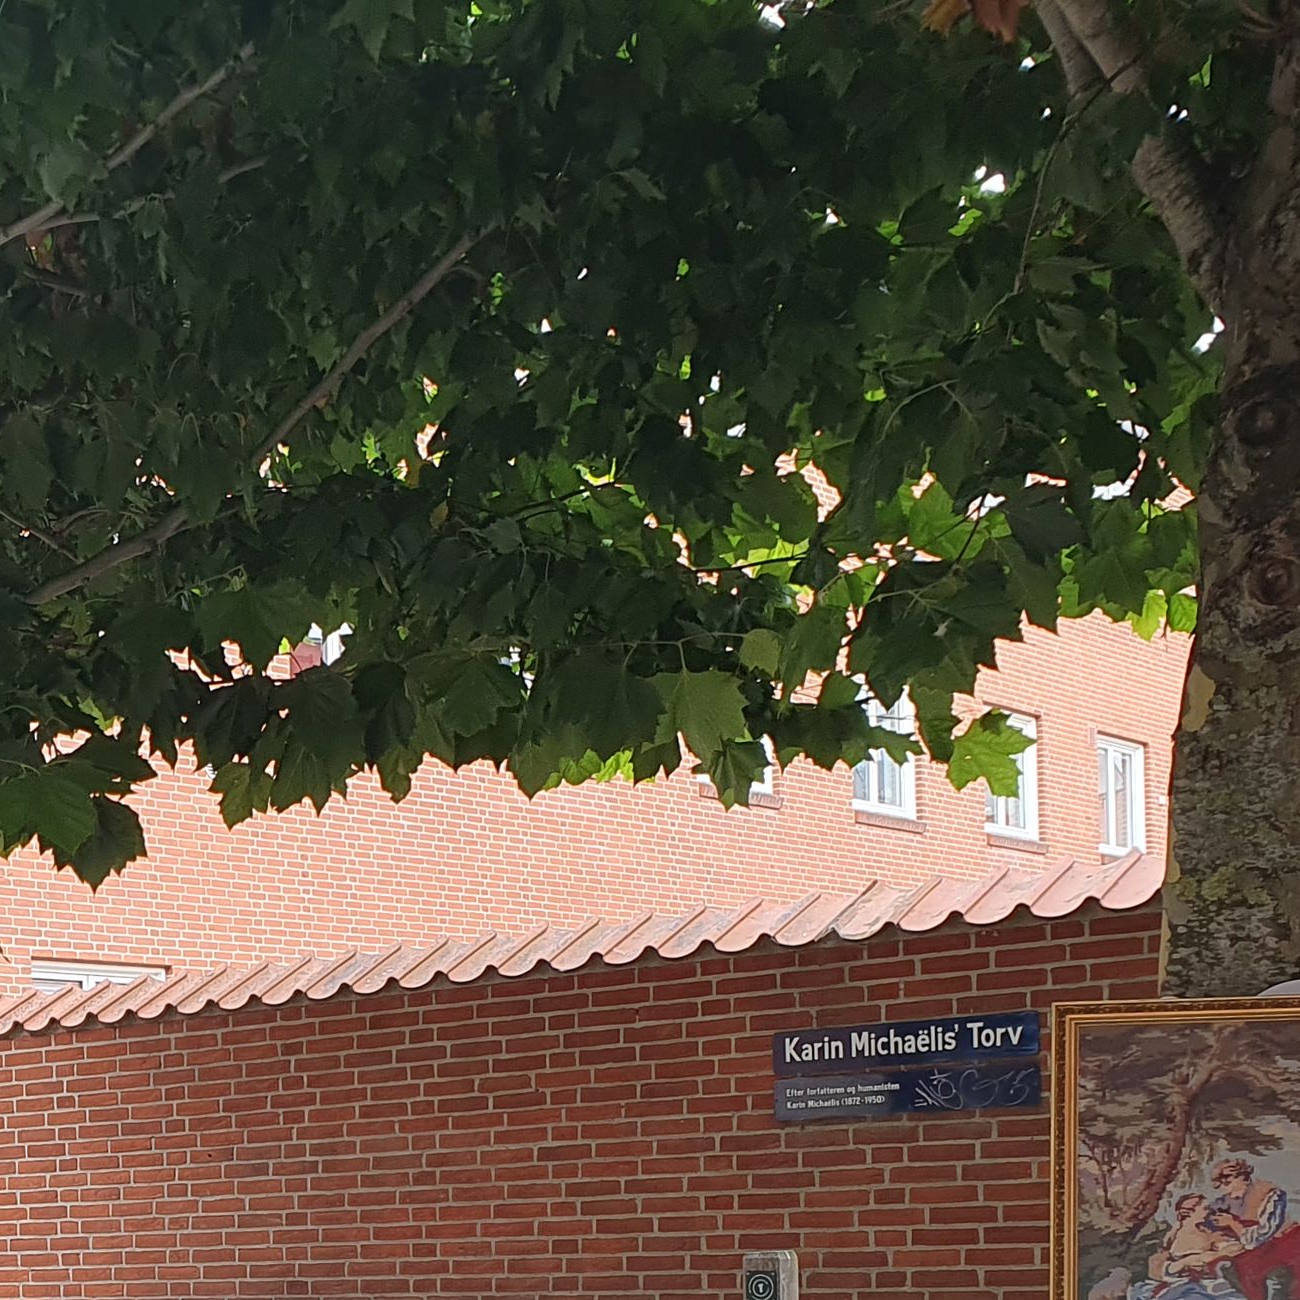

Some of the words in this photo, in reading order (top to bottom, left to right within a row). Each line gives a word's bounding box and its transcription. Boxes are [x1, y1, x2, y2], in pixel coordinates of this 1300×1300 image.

[784, 1036, 844, 1063] Karin
[966, 1022, 1024, 1049] Torv
[786, 1088, 804, 1097] Efter
[807, 1086, 845, 1096] forfatteren
[846, 1086, 855, 1095] og
[857, 1082, 900, 1092] humanisten
